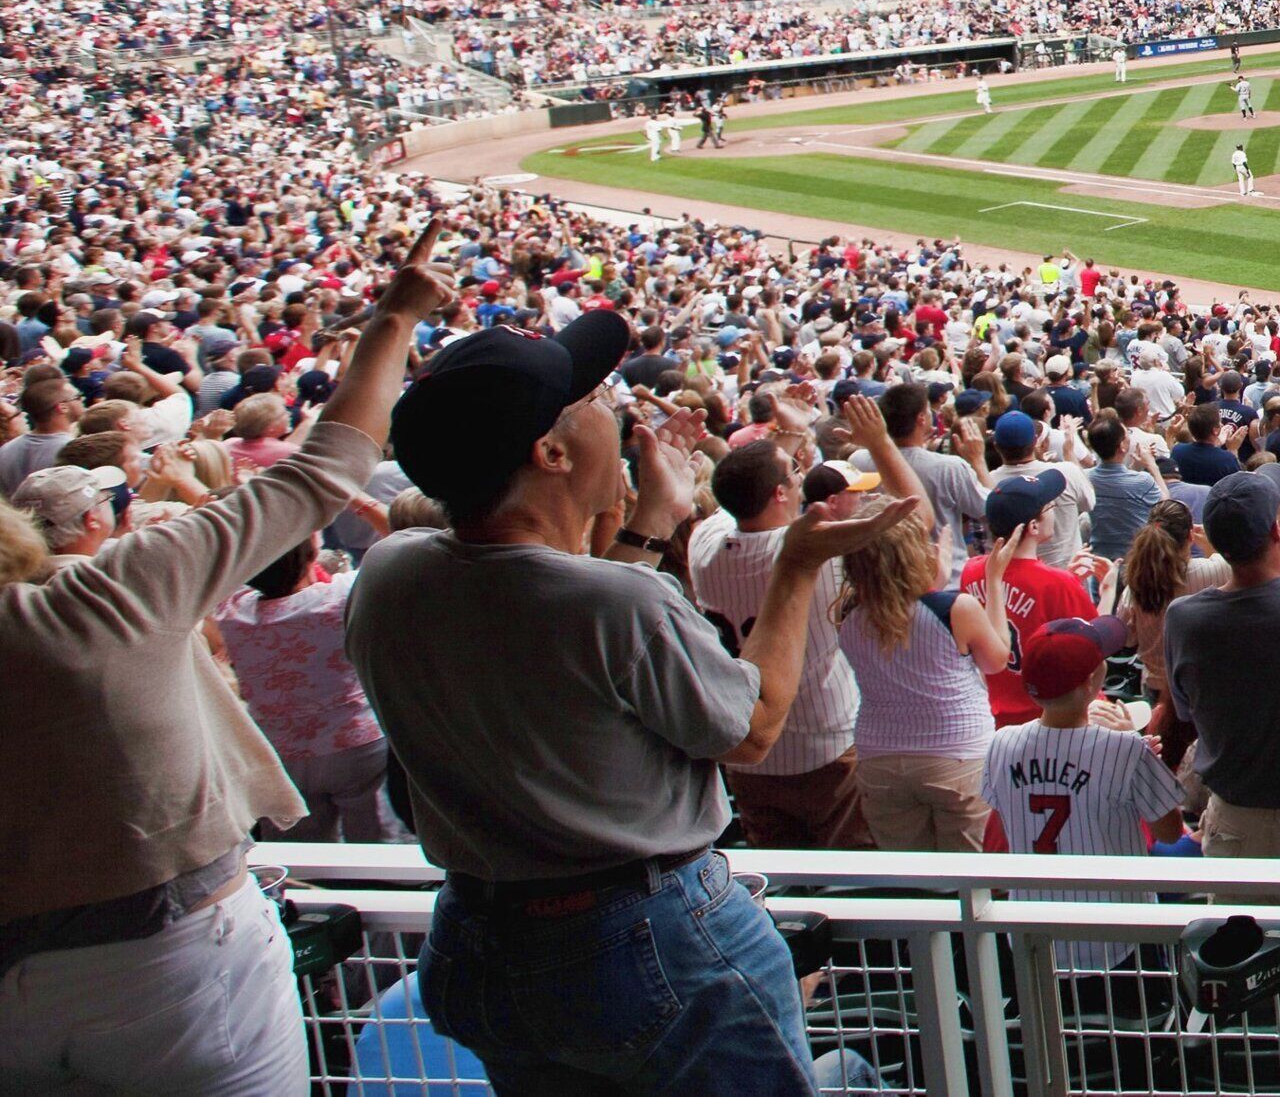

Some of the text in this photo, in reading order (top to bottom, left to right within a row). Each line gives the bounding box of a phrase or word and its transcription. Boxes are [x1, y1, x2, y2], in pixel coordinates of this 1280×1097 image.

[1010, 758, 1091, 796] MAUER
[1028, 794, 1071, 854] 7
[1201, 979, 1228, 1008] T
